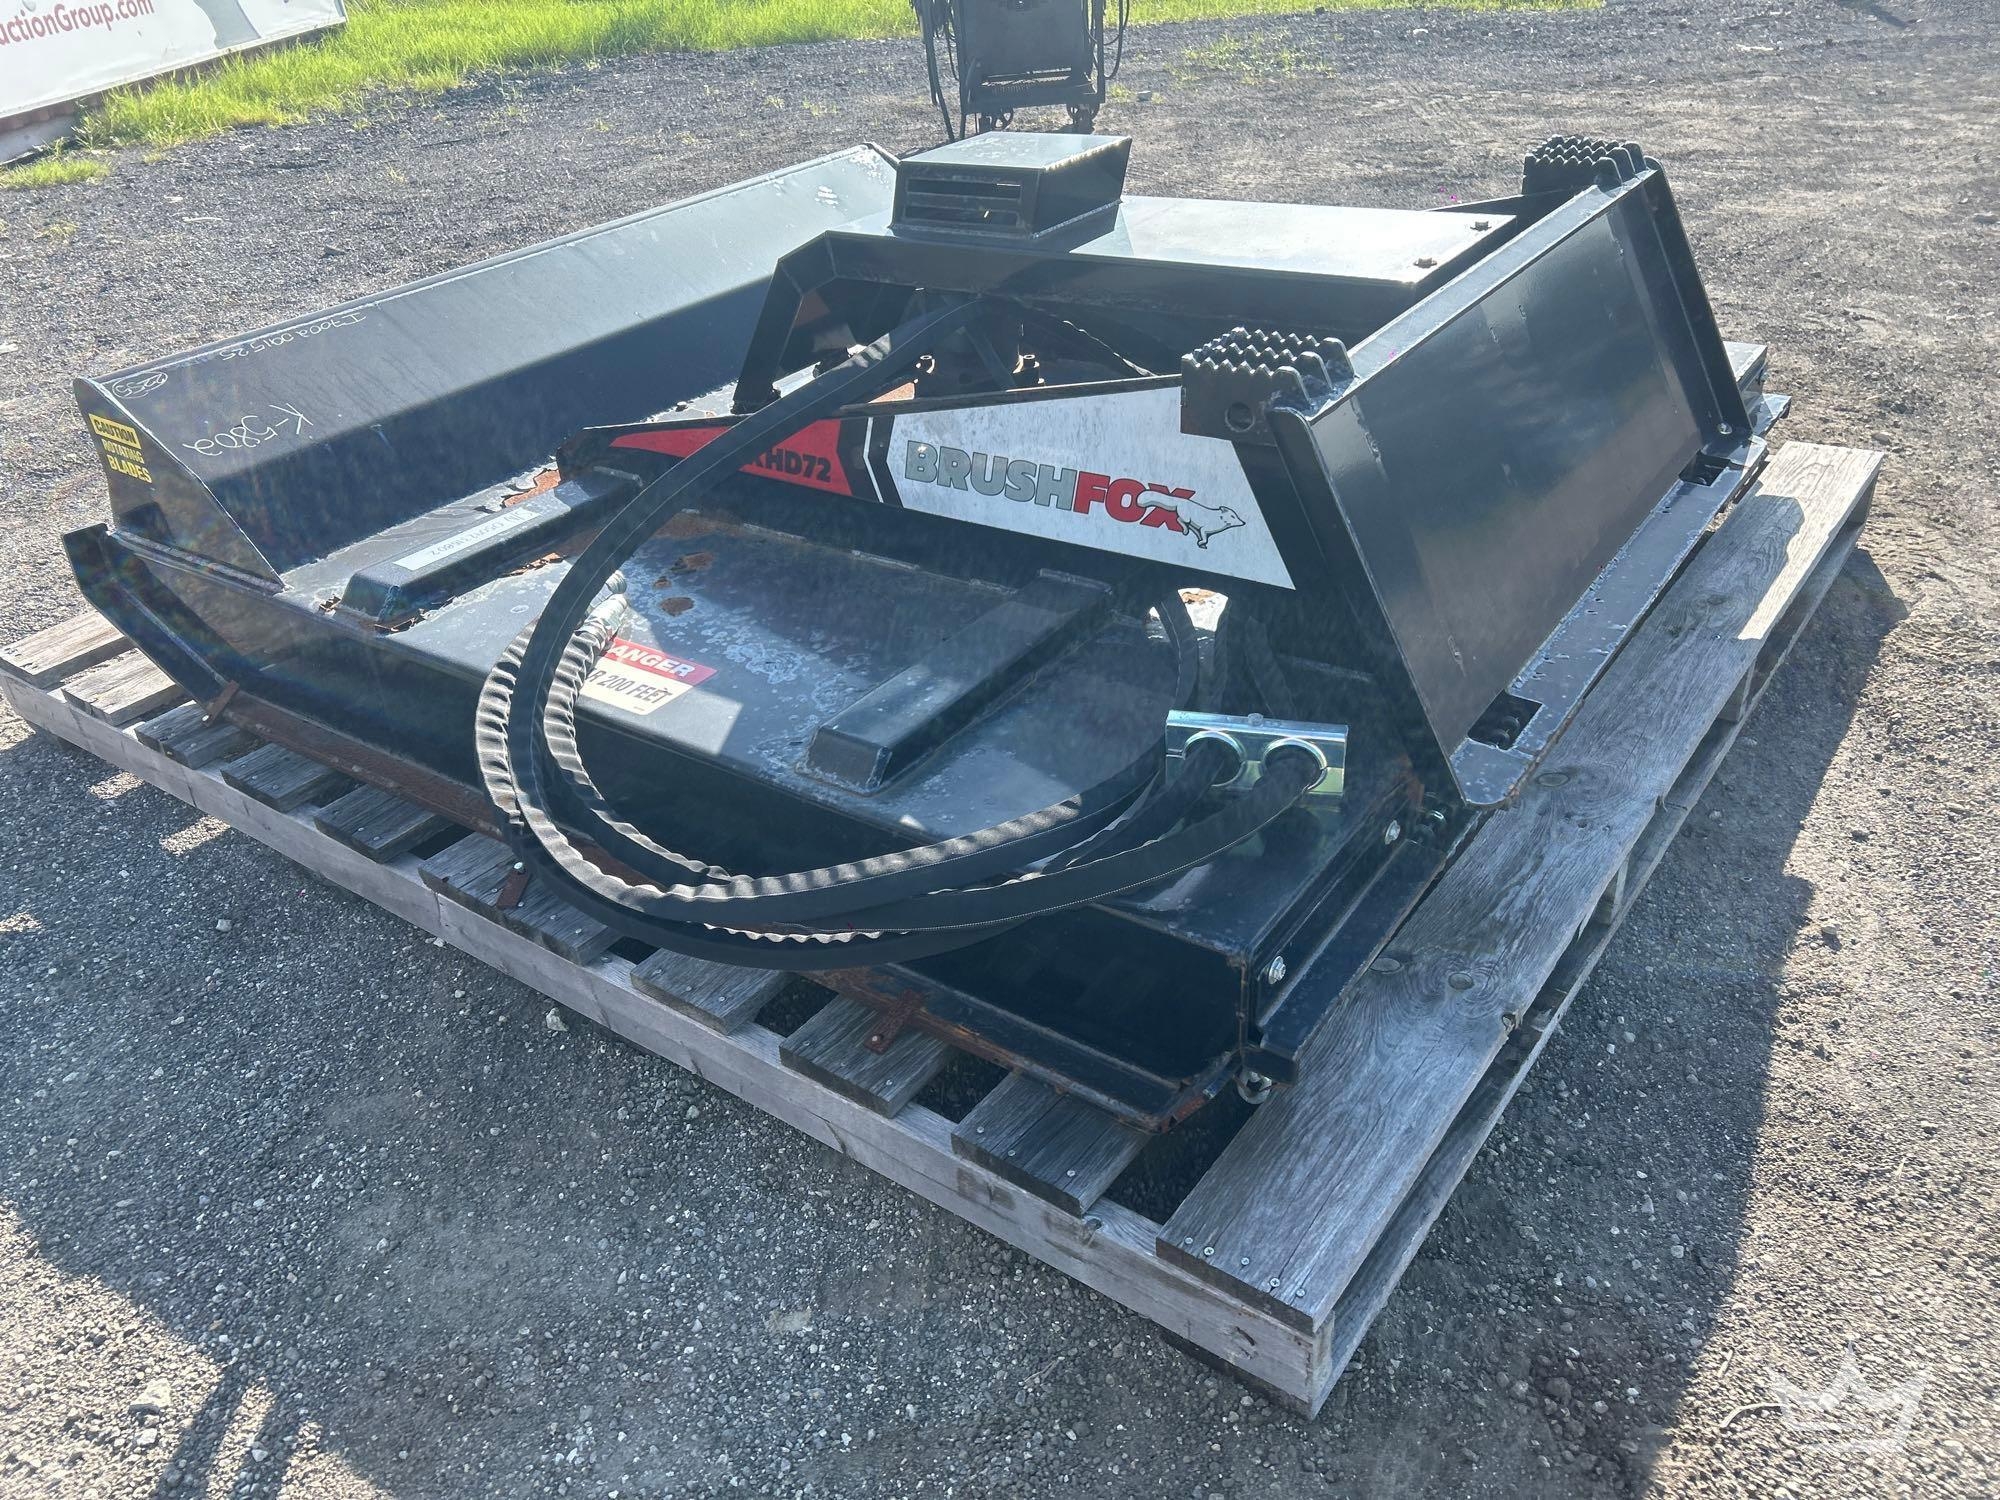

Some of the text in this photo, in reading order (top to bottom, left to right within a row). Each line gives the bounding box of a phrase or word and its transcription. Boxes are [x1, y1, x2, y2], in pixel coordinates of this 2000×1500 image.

[93, 419, 137, 445] CAUTION
[183, 403, 313, 457] K-5802
[107, 454, 153, 483] BLADES
[609, 644, 696, 678] ANGER
[596, 675, 634, 693] 200
[626, 684, 672, 704] FEET
